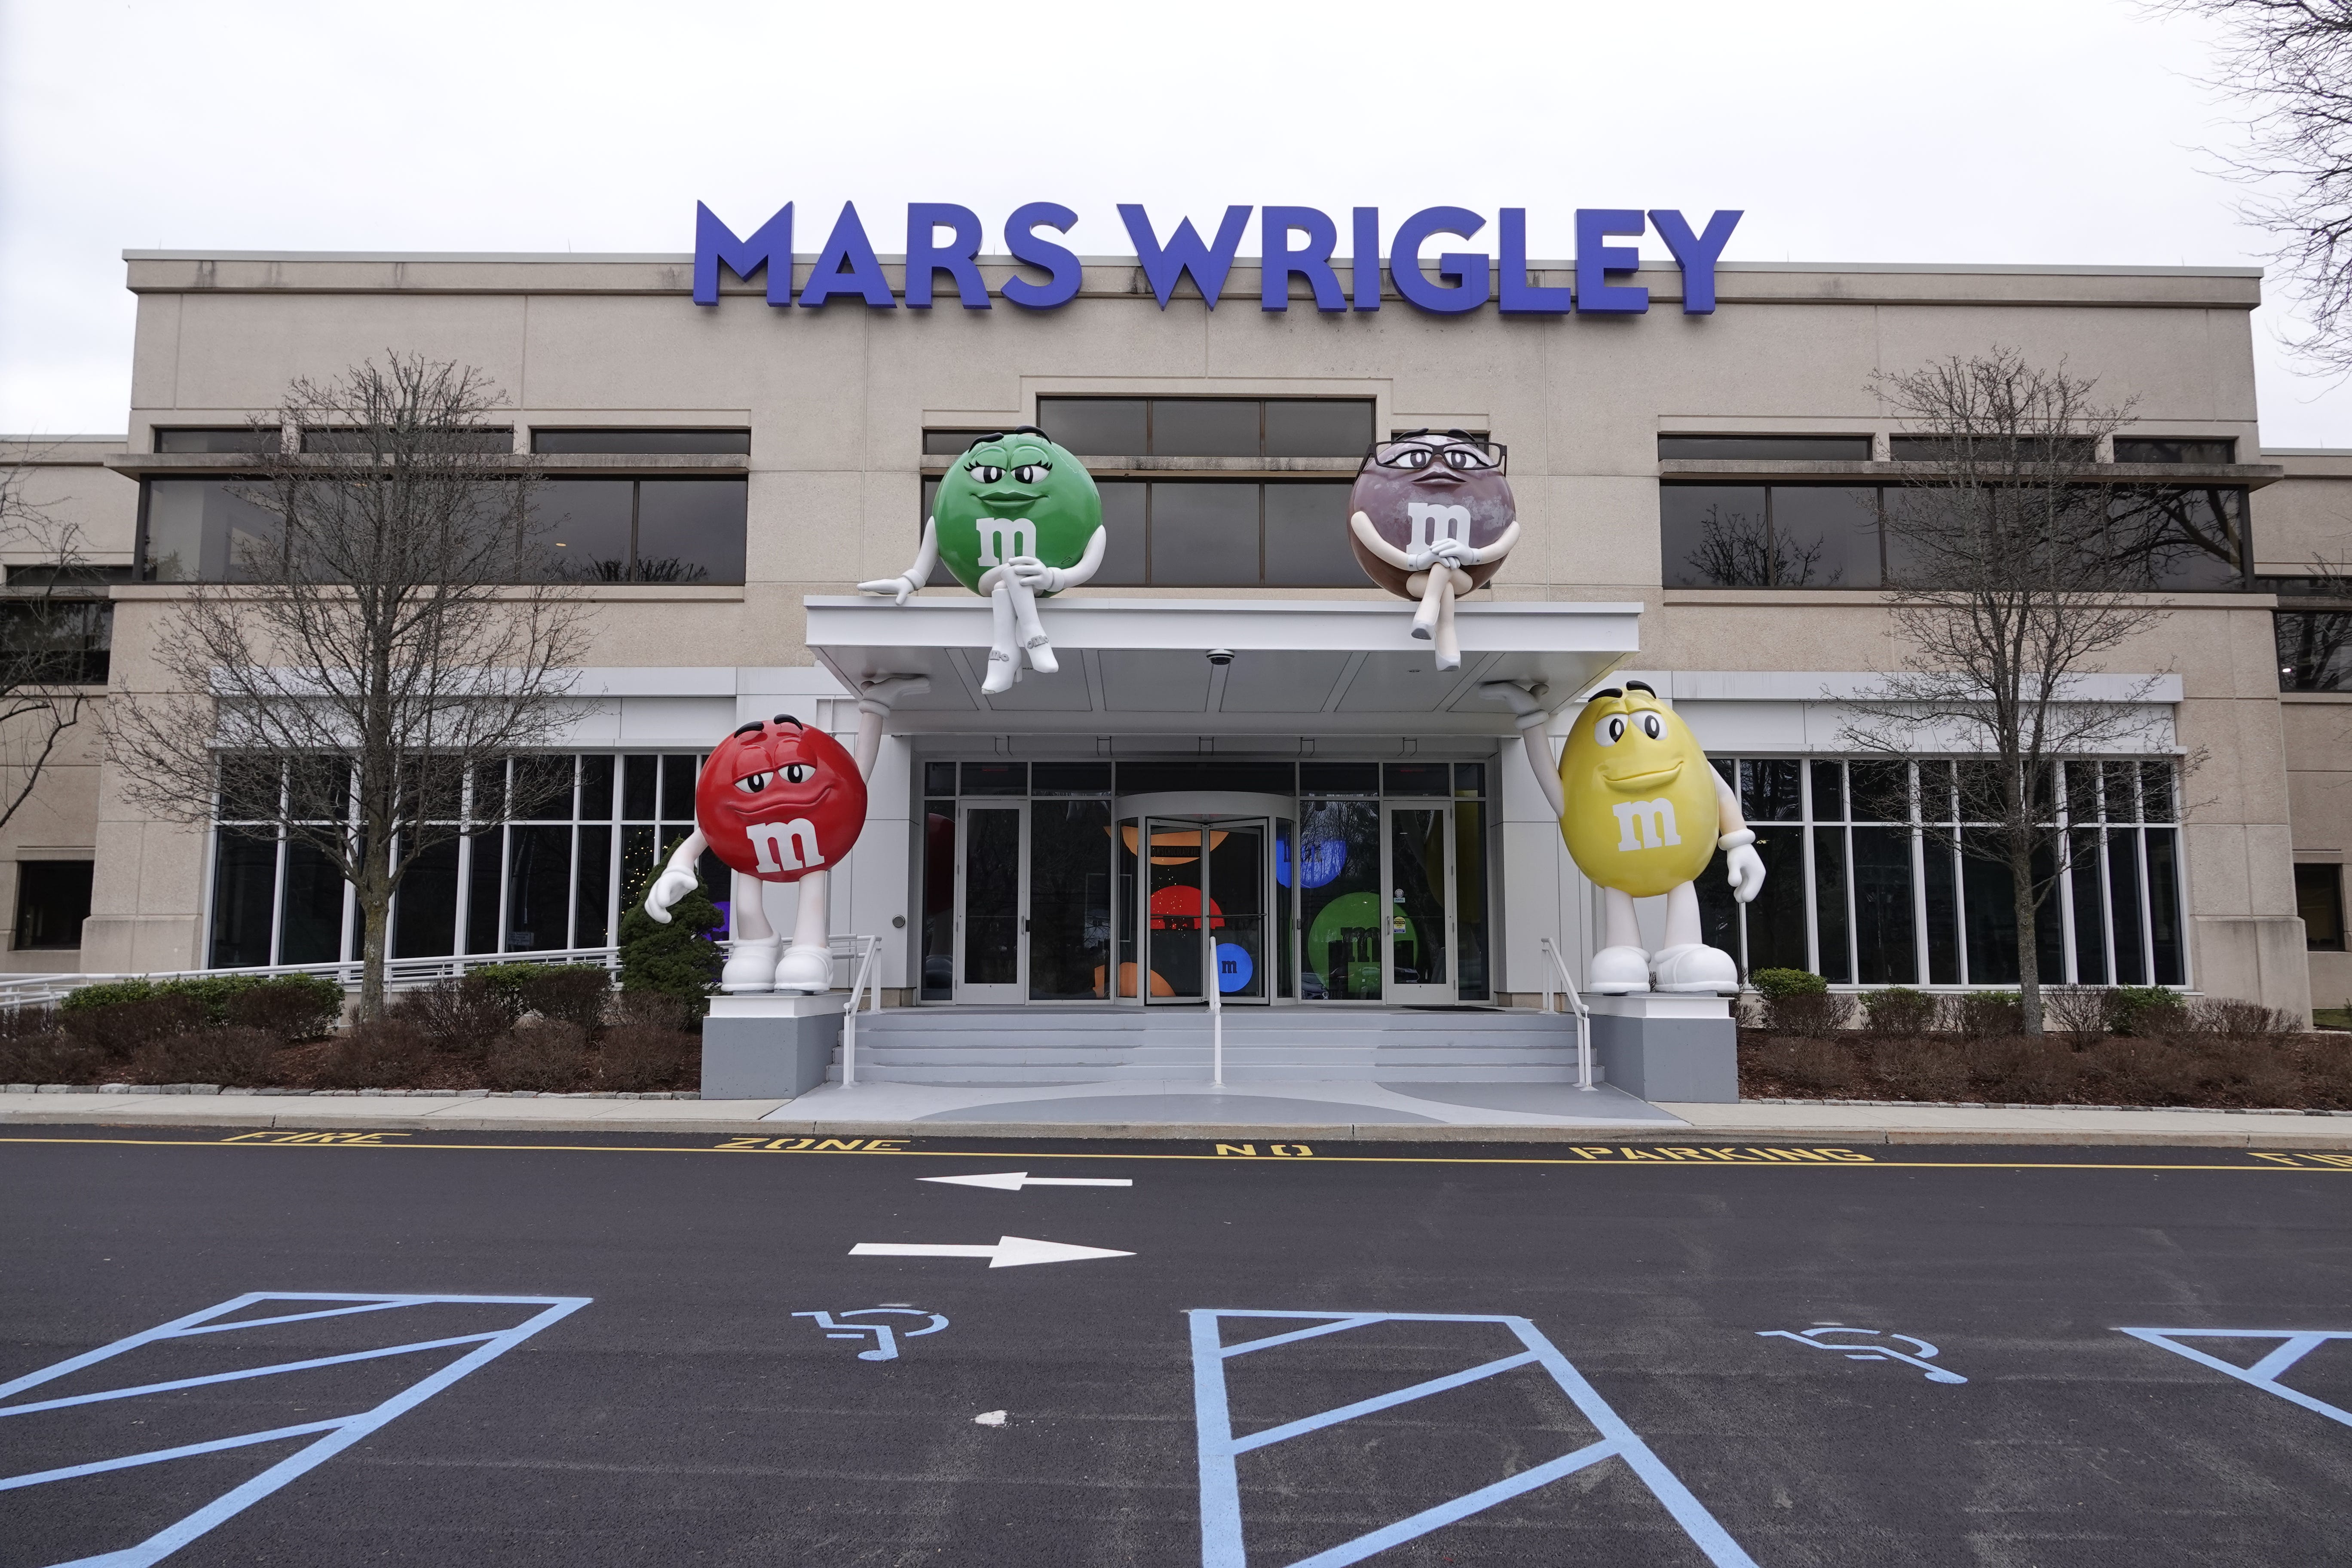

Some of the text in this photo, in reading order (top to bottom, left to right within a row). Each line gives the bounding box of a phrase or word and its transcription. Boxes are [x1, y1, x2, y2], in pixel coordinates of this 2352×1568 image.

[692, 200, 1745, 316] MARS WRIGLEY
[976, 518, 1040, 566] m
[1406, 502, 1470, 554] m
[746, 818, 825, 873] m
[1612, 797, 1681, 851] m
[1222, 961, 1237, 974] m
[1340, 927, 1381, 962] m
[220, 1131, 413, 1144] FIRE
[714, 1137, 911, 1151] ZONE
[1216, 1144, 1314, 1157] NO
[1568, 1147, 1875, 1161] PARKING
